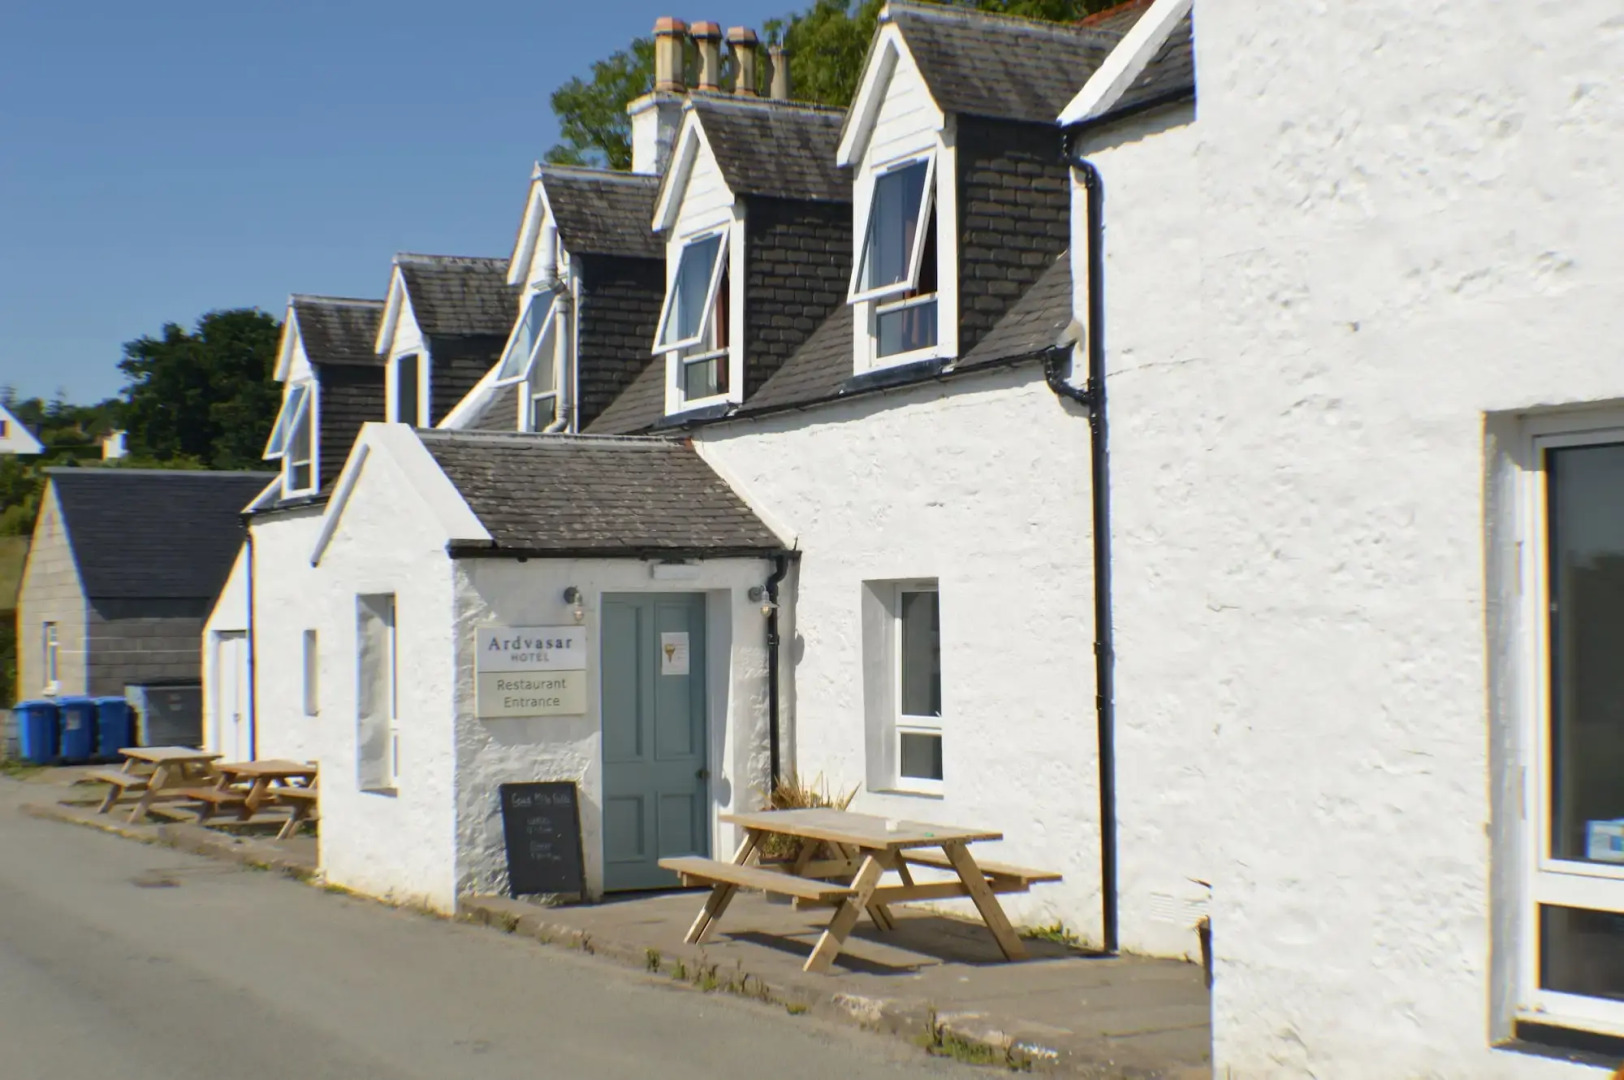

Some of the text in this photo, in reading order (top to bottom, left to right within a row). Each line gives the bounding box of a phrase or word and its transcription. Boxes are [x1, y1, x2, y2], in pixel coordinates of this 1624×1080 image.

[488, 635, 572, 651] Ardvasar
[510, 652, 550, 662] HOTEL
[497, 678, 567, 691] Restaurant
[504, 697, 560, 708] Entrance
